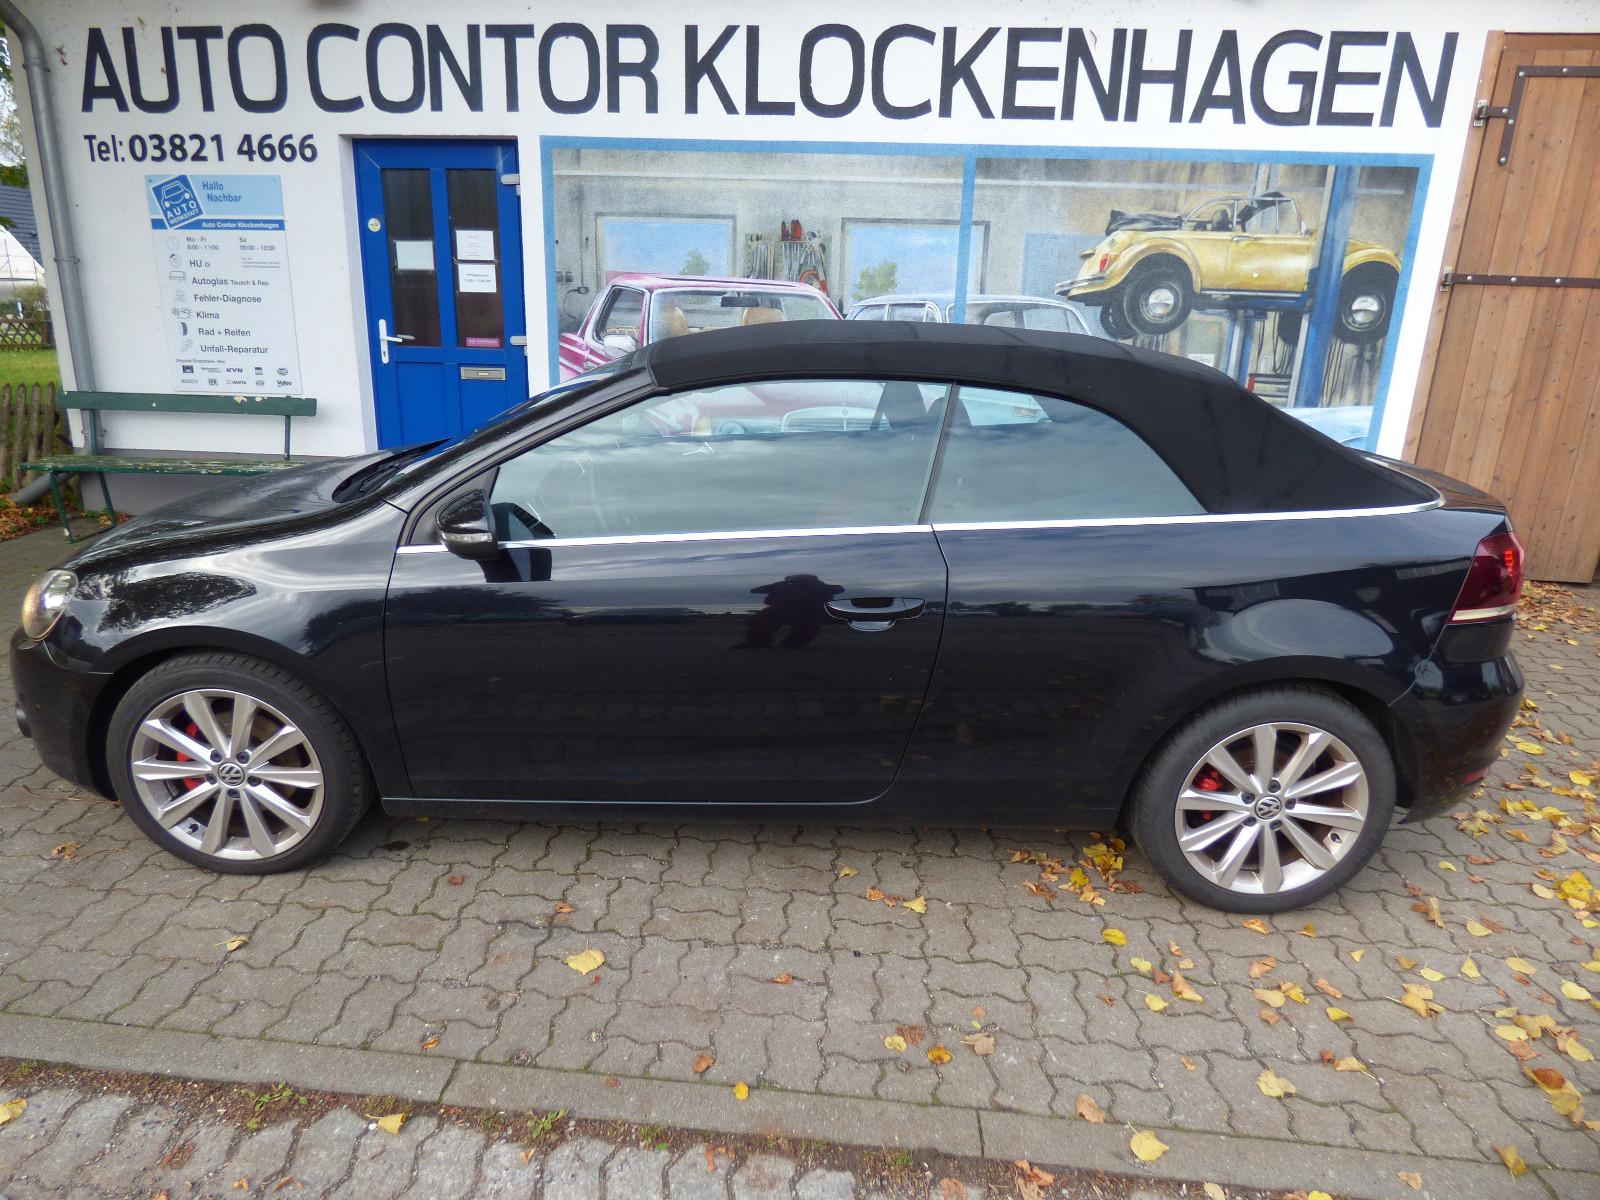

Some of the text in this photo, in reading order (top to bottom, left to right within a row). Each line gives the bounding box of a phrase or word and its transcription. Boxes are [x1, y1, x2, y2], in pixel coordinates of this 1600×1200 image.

[81, 22, 1459, 128] AUTO CONTOR KLOCKENHAGEN
[236, 133, 318, 163] 4666
[202, 181, 224, 191] Hallo
[207, 193, 242, 203] Nachbar
[166, 200, 197, 220] AUTO
[189, 259, 202, 268] HU
[192, 276, 229, 287] Autoglas
[193, 294, 262, 304] Fehler-Diagnose
[196, 311, 220, 320] Klima
[198, 327, 215, 336] Rad
[224, 328, 251, 337] Reifen
[200, 344, 269, 354] Unfall-Reparatur
